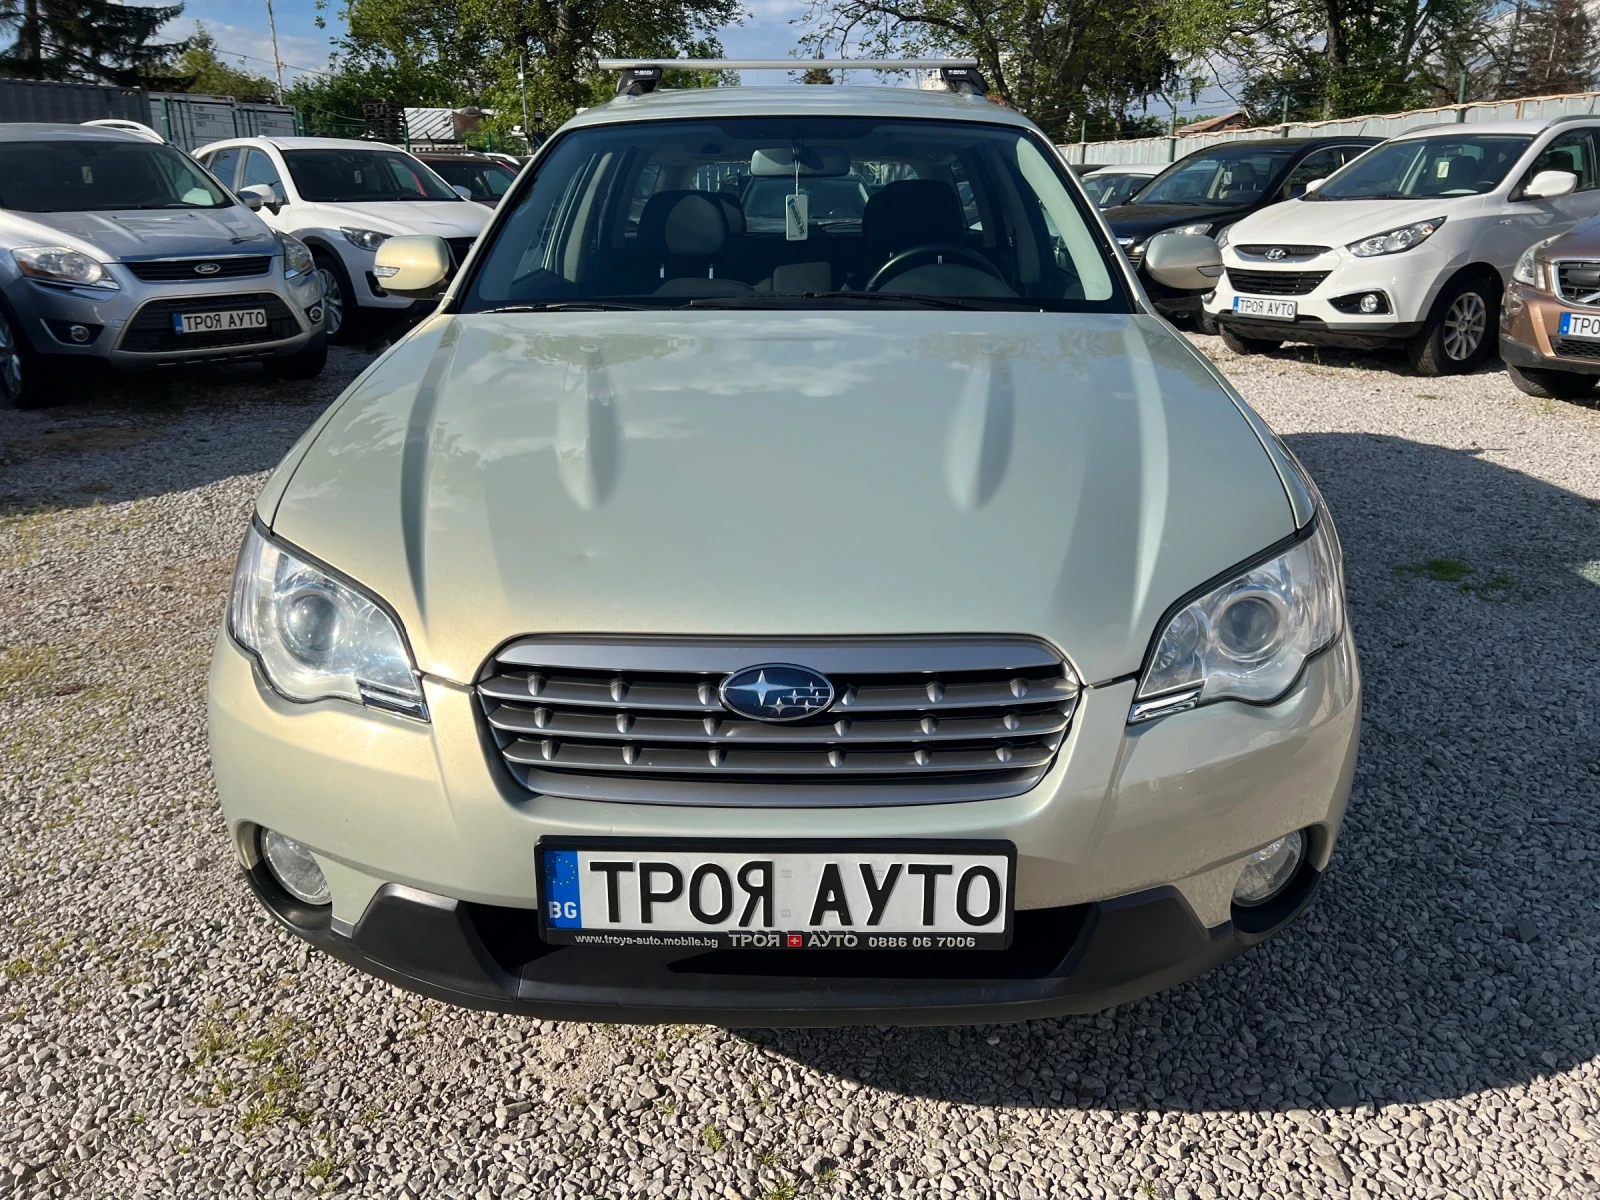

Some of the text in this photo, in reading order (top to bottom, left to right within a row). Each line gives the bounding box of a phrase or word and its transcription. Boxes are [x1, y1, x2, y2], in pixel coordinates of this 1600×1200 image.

[1240, 299, 1294, 316] ТРОЯ АУТО
[183, 311, 265, 331] ТРОЯ АУТО
[588, 860, 1002, 928] ТРОЯ АУТО
[549, 901, 578, 919] BG
[574, 933, 719, 949] www.troya-auto.mobile.bg
[728, 932, 976, 948] ТРОЯ АУТО 0886 06 7006
